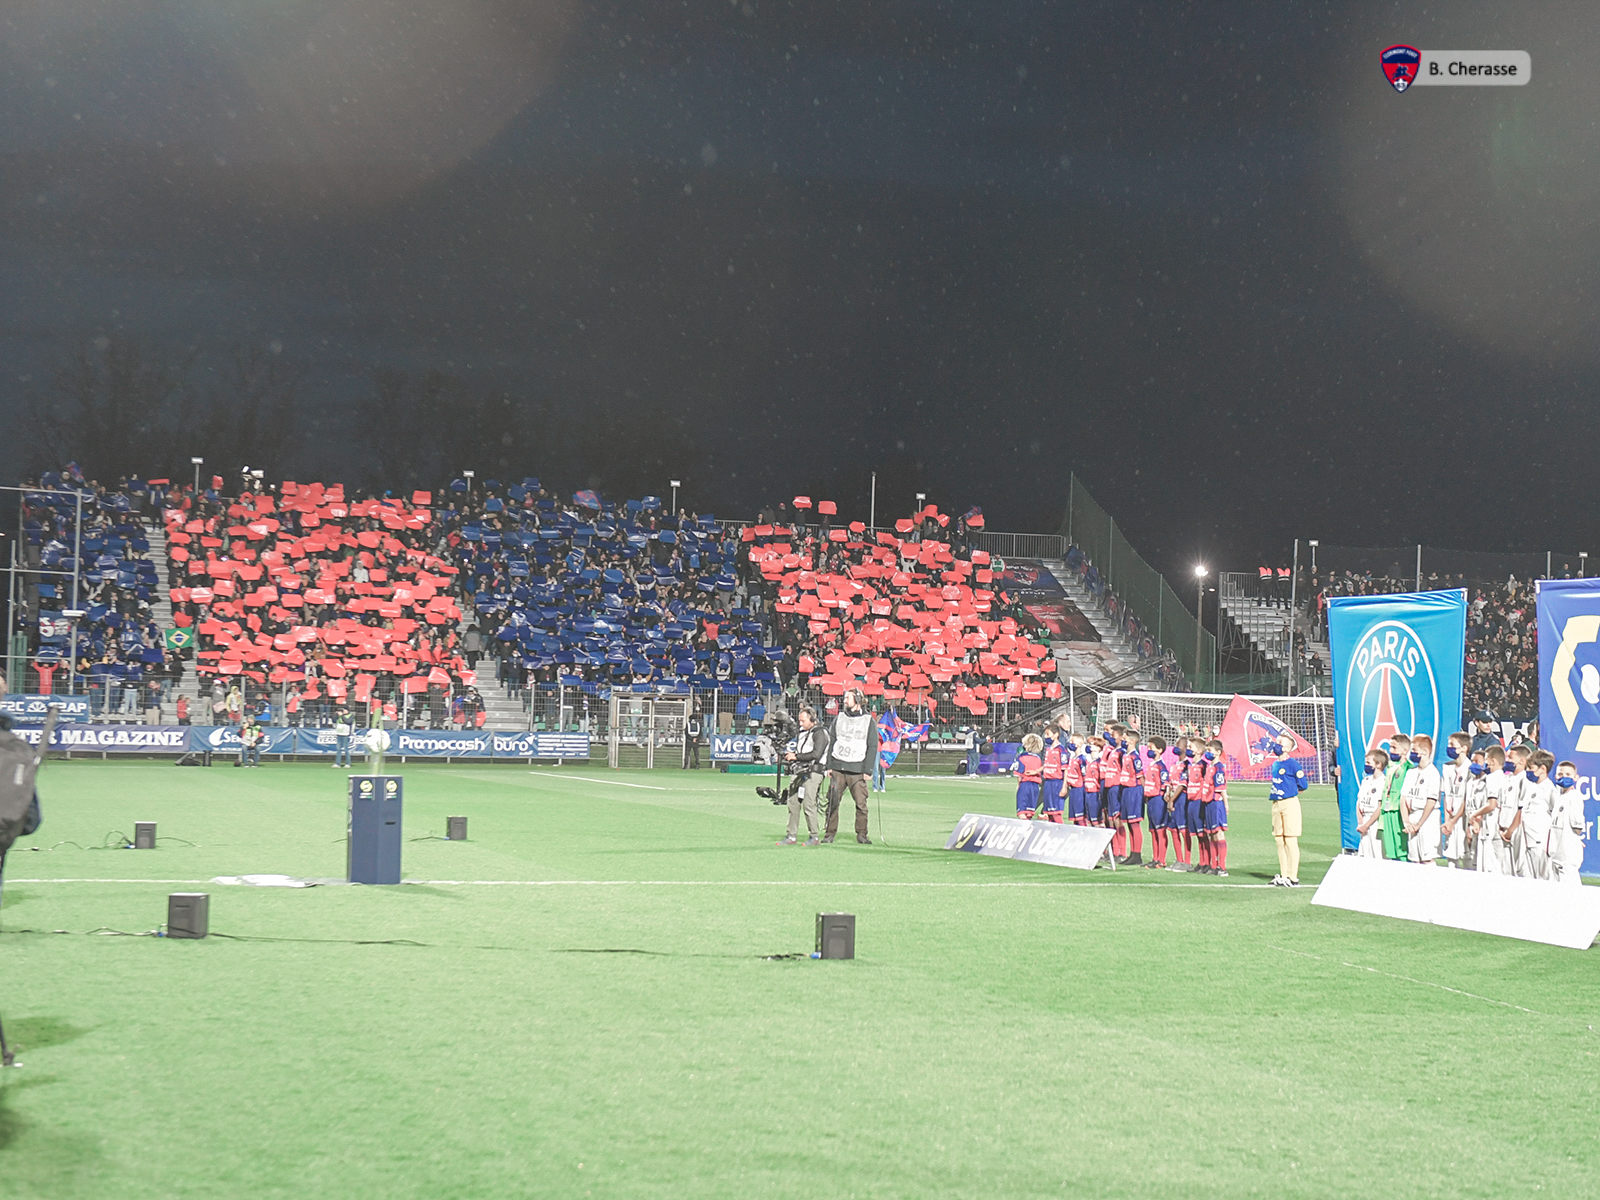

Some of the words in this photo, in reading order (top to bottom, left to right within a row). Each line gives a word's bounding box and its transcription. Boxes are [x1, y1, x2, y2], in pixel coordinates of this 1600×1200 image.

[1356, 630, 1420, 678] PARIS
[60, 730, 184, 746] MAGAZINE
[399, 735, 486, 751] Promocash
[838, 745, 851, 757] 29
